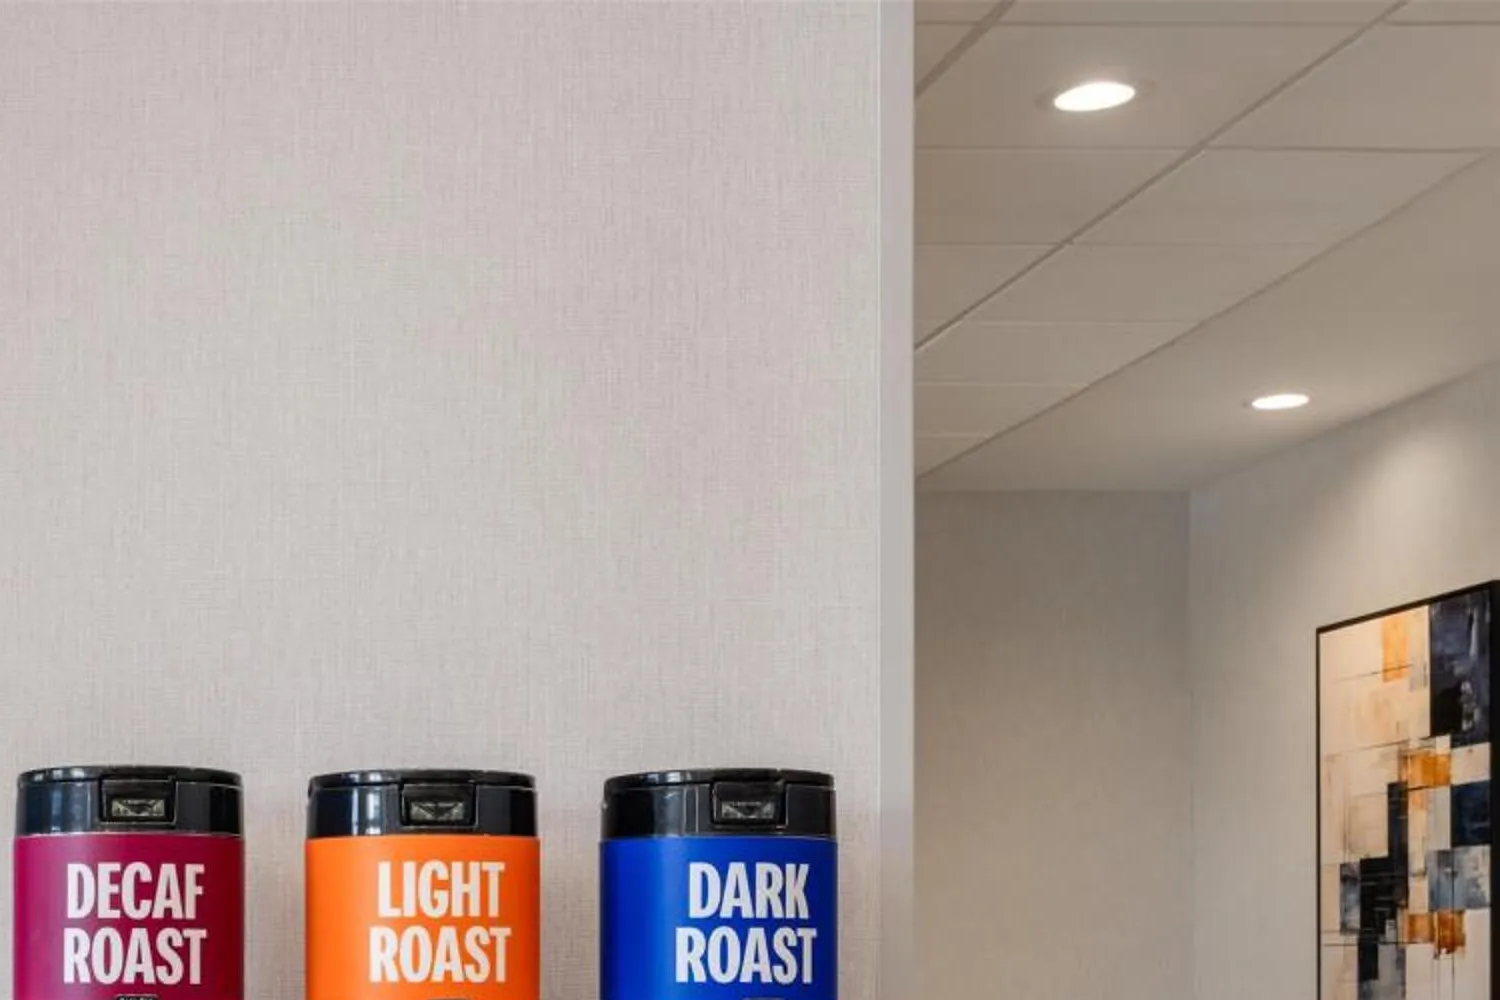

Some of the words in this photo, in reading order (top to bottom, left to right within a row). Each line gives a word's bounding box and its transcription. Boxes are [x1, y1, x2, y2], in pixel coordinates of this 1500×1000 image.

[66, 861, 204, 920] DECAF
[377, 859, 506, 919] LIGHT
[688, 861, 811, 920] DARK
[63, 927, 207, 985] ROAST
[369, 925, 512, 983] ROAST
[675, 926, 817, 984] ROAST
